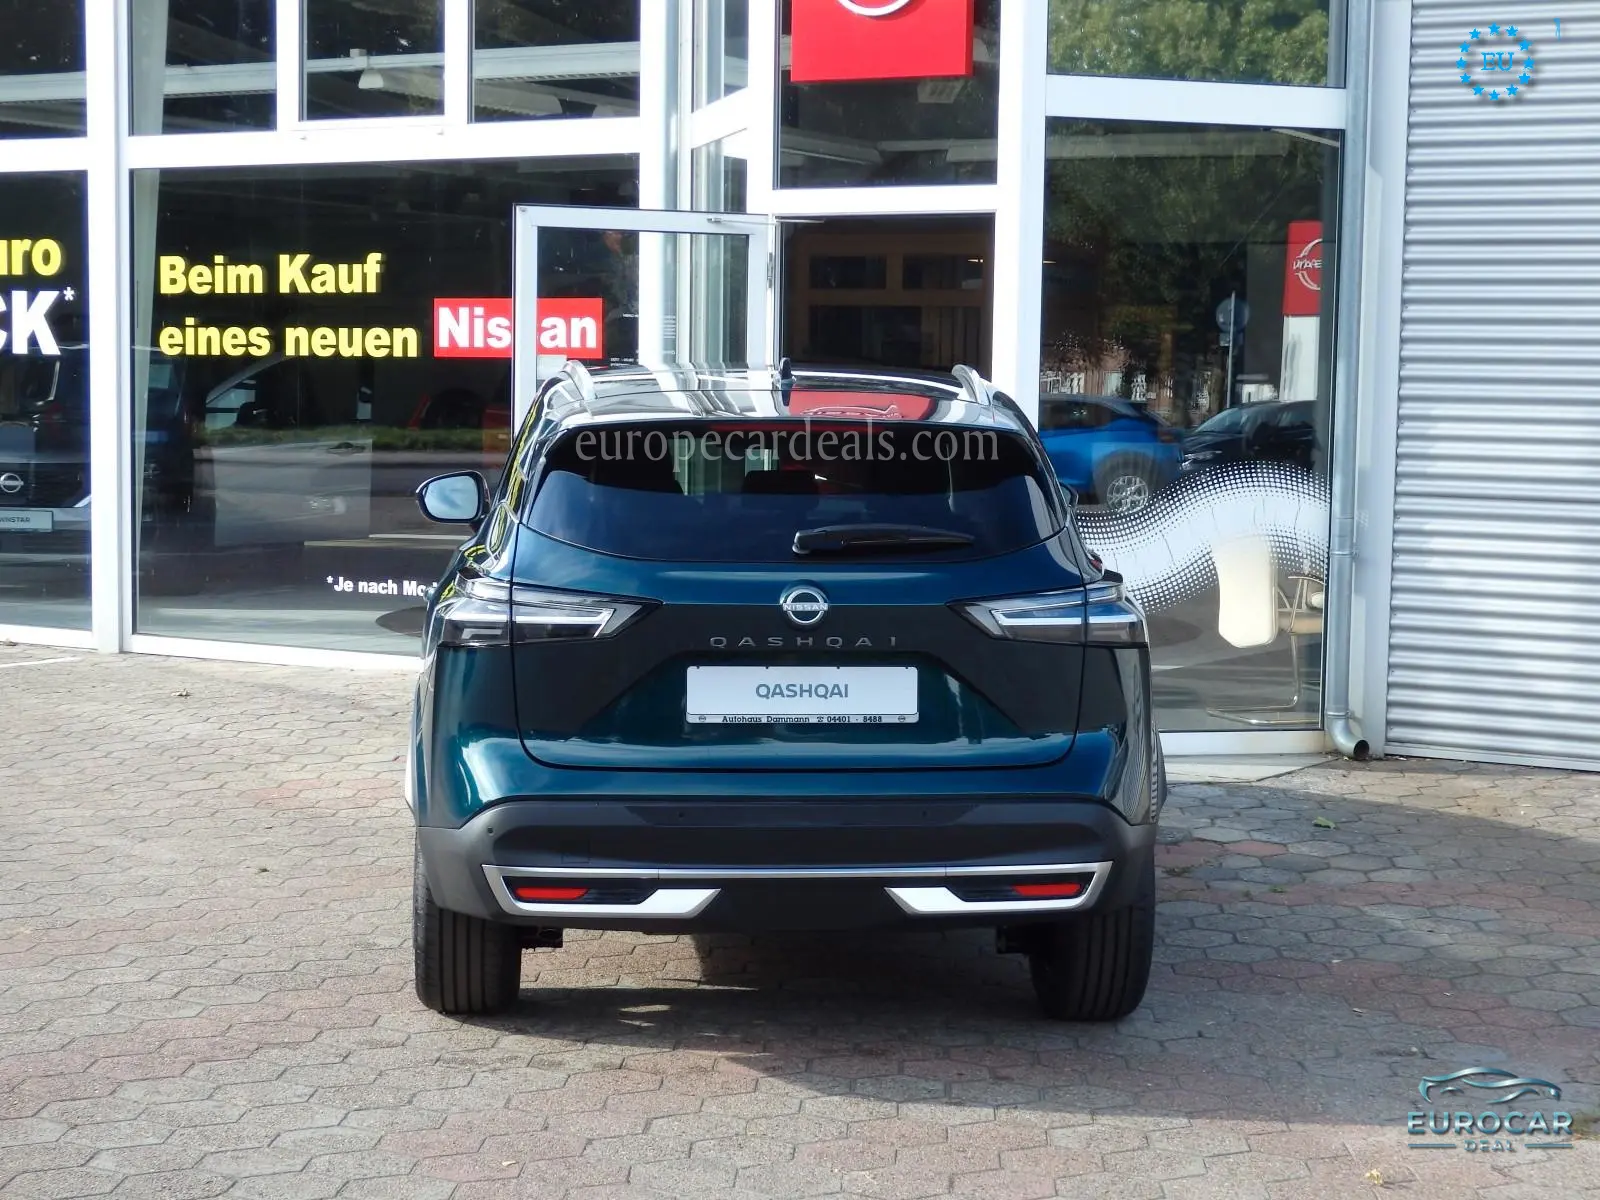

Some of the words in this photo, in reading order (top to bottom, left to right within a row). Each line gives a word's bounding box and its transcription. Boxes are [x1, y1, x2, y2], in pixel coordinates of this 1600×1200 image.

[159, 254, 264, 294] Beim
[279, 252, 382, 294] Kauf
[159, 316, 272, 356] eines
[285, 326, 418, 358] neuen
[438, 306, 598, 349] Nisan
[358, 579, 398, 595] nach
[402, 580, 437, 597] Mo
[783, 602, 829, 612] NISSAN
[709, 636, 897, 649] QASHQAI
[755, 683, 849, 699] QASHQAI
[721, 715, 762, 723] Autohaus
[766, 715, 810, 723] Dammann
[826, 715, 850, 723] 04401
[862, 715, 882, 723] 8488
